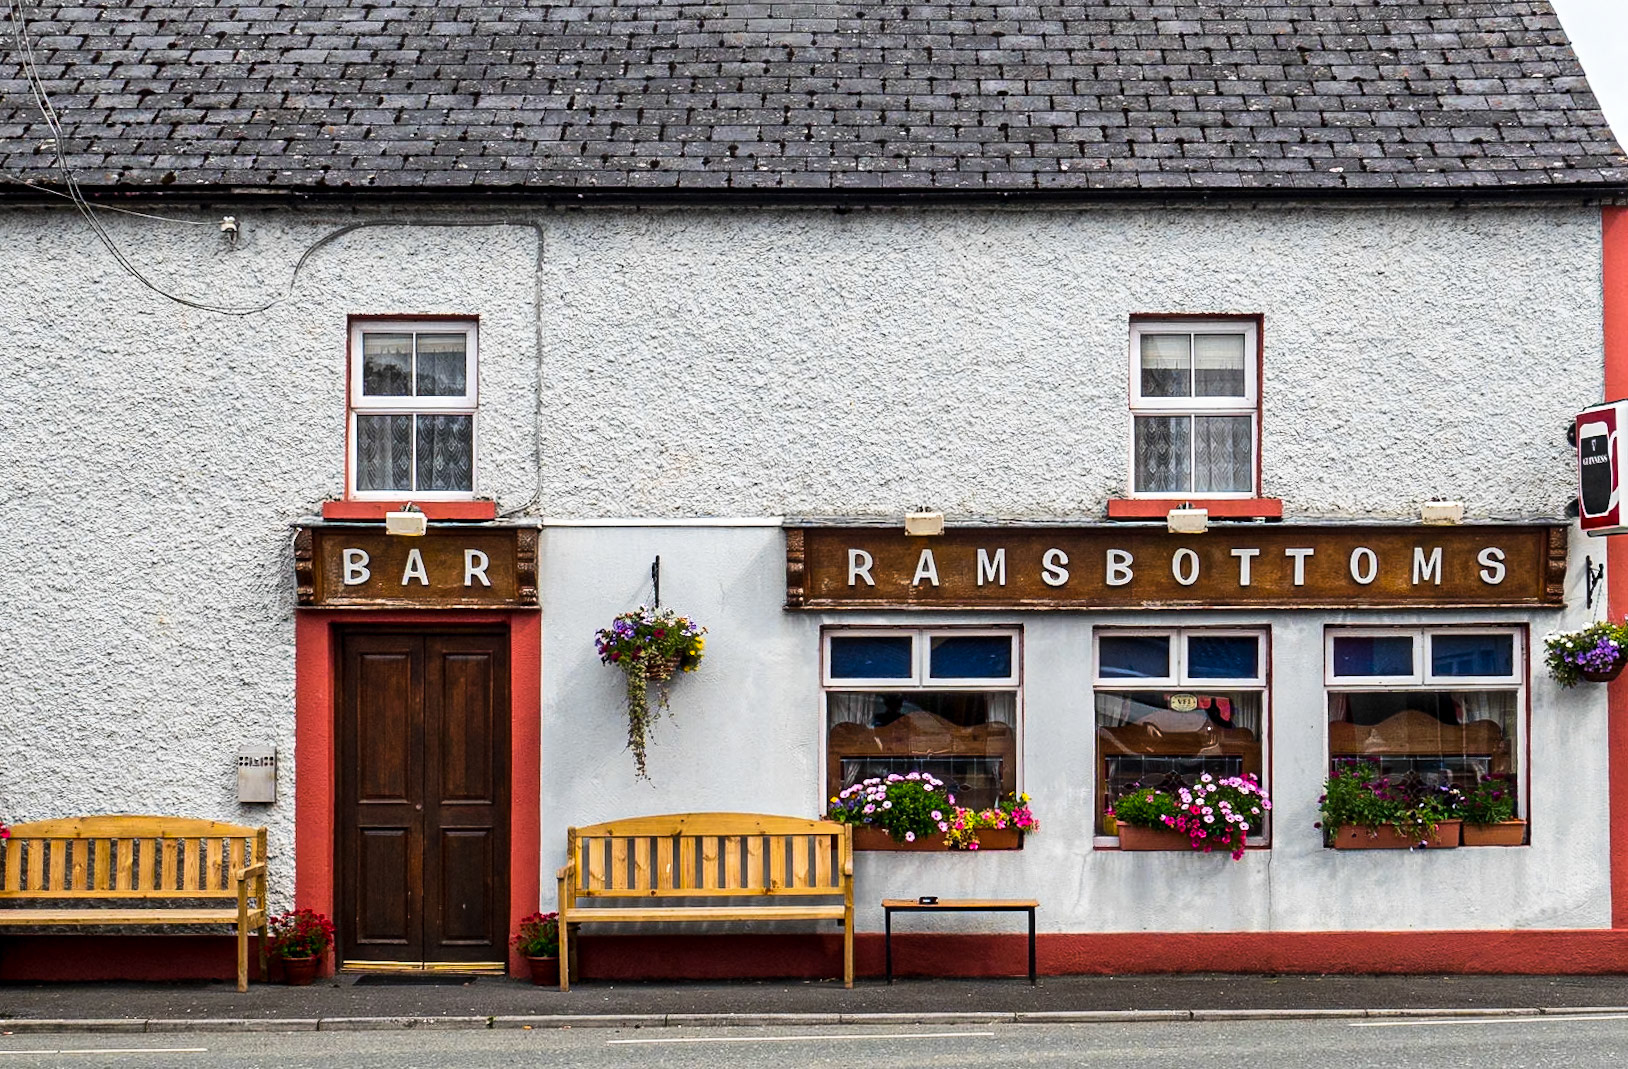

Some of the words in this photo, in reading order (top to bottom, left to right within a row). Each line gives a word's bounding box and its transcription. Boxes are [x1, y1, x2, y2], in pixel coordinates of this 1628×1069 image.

[1583, 454, 1608, 466] GUINNESS
[342, 548, 491, 586] BAR
[848, 547, 1506, 586] RAMSBOTTOMS
